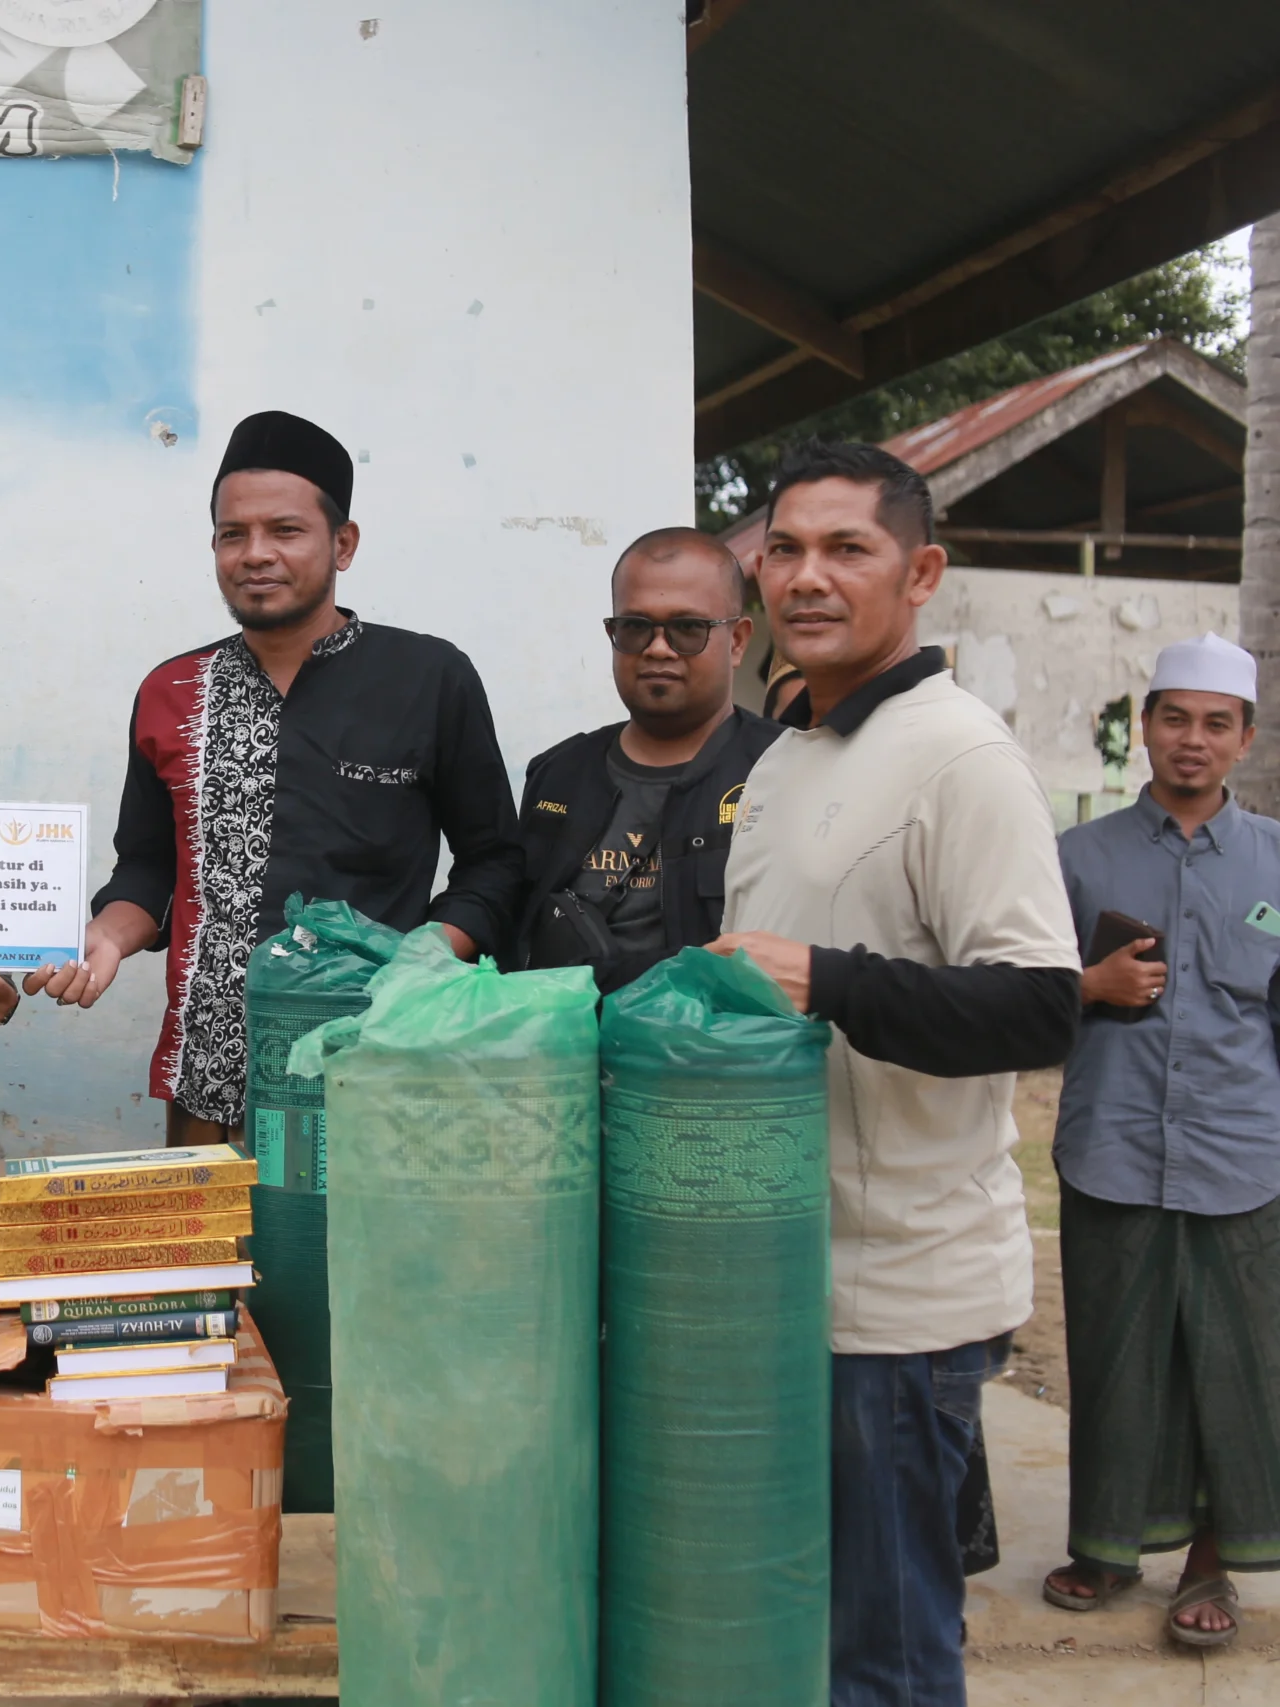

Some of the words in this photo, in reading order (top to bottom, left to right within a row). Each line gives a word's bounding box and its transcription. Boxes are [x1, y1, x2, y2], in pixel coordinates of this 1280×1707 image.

[536, 800, 567, 814] AFRIZAL
[36, 823, 74, 839] JHK
[29, 859, 44, 871] di
[30, 880, 49, 892] ya
[10, 900, 57, 912] sudah
[18, 953, 42, 961] KITA
[64, 1305, 113, 1318] QURAN
[118, 1300, 187, 1314] CORDOBA
[121, 1319, 183, 1333] AL-HUFAZ
[2, 1500, 18, 1509] dos
